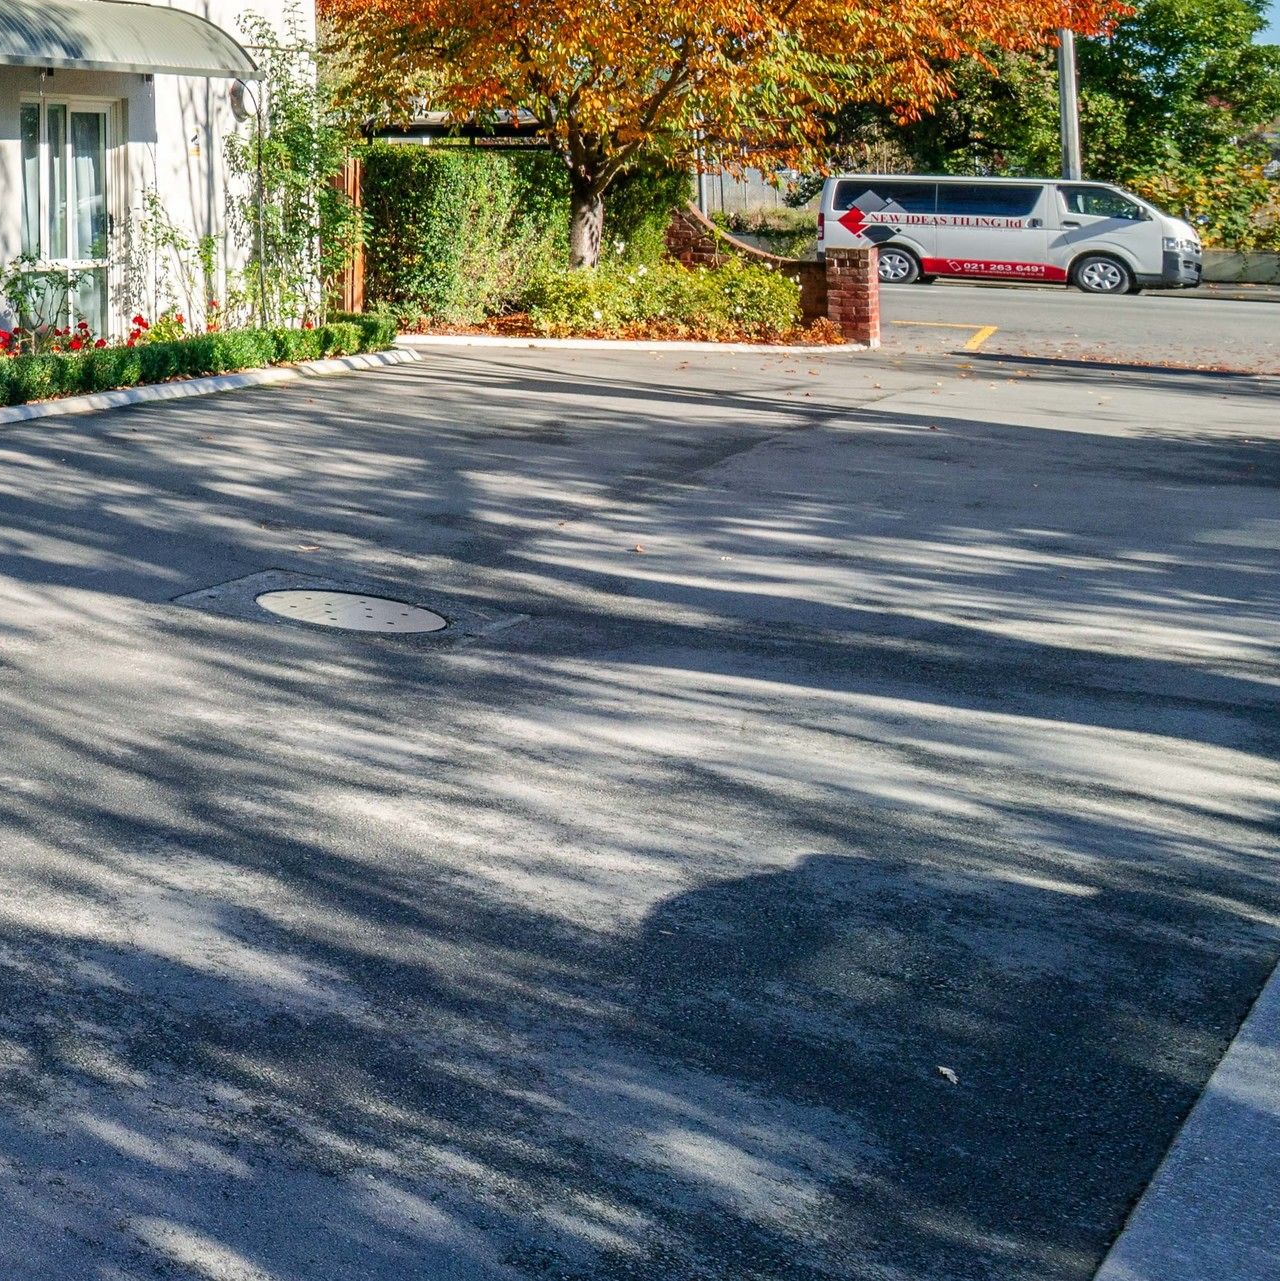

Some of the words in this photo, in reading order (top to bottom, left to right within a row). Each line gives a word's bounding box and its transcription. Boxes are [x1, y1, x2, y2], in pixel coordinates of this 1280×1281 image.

[871, 214, 902, 224] NEW
[906, 215, 947, 226] IDEAS
[951, 217, 1001, 227] TILING
[1005, 219, 1022, 228] ltd
